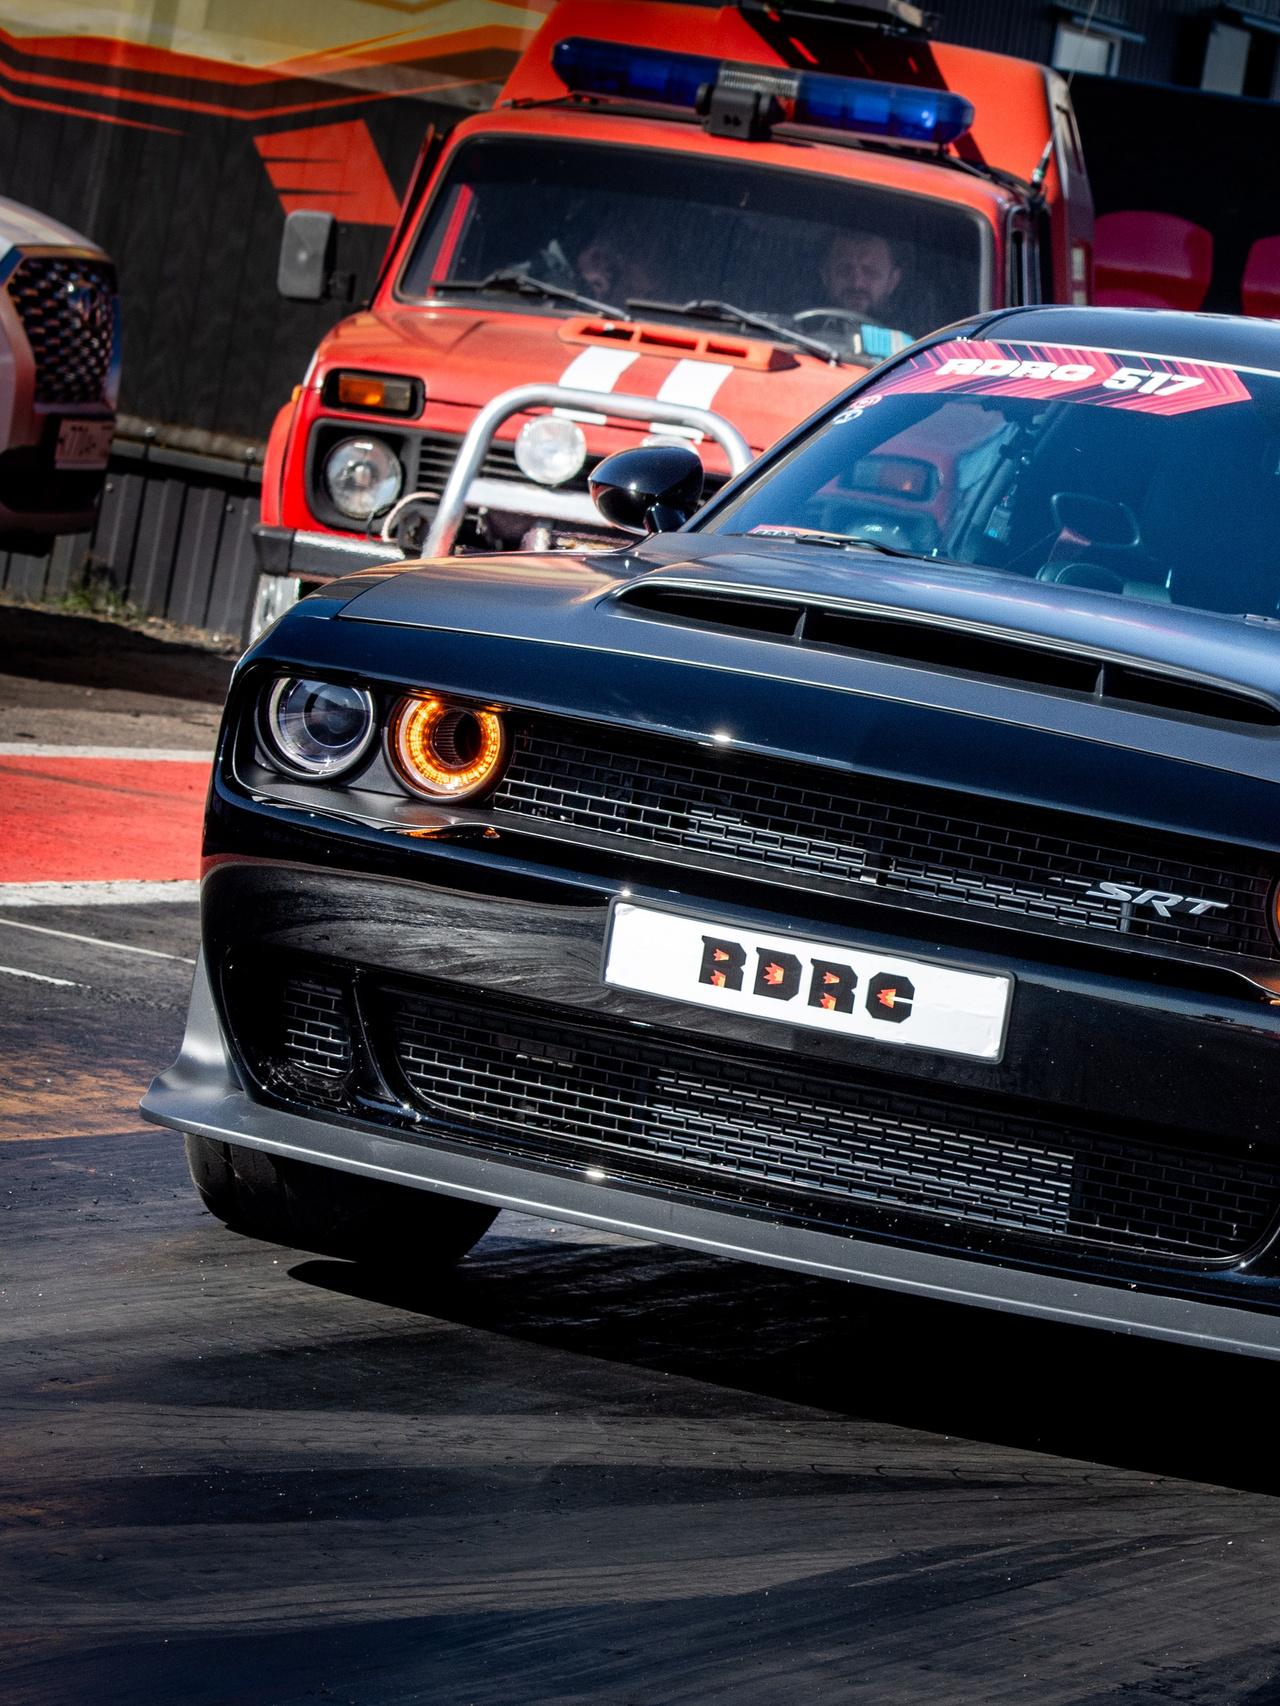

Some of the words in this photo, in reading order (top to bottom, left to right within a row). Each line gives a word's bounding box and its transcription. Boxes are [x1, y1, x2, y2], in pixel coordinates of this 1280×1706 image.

[1102, 366, 1205, 396] 517
[1085, 881, 1229, 918] SRT
[698, 935, 915, 1024] RDRC
